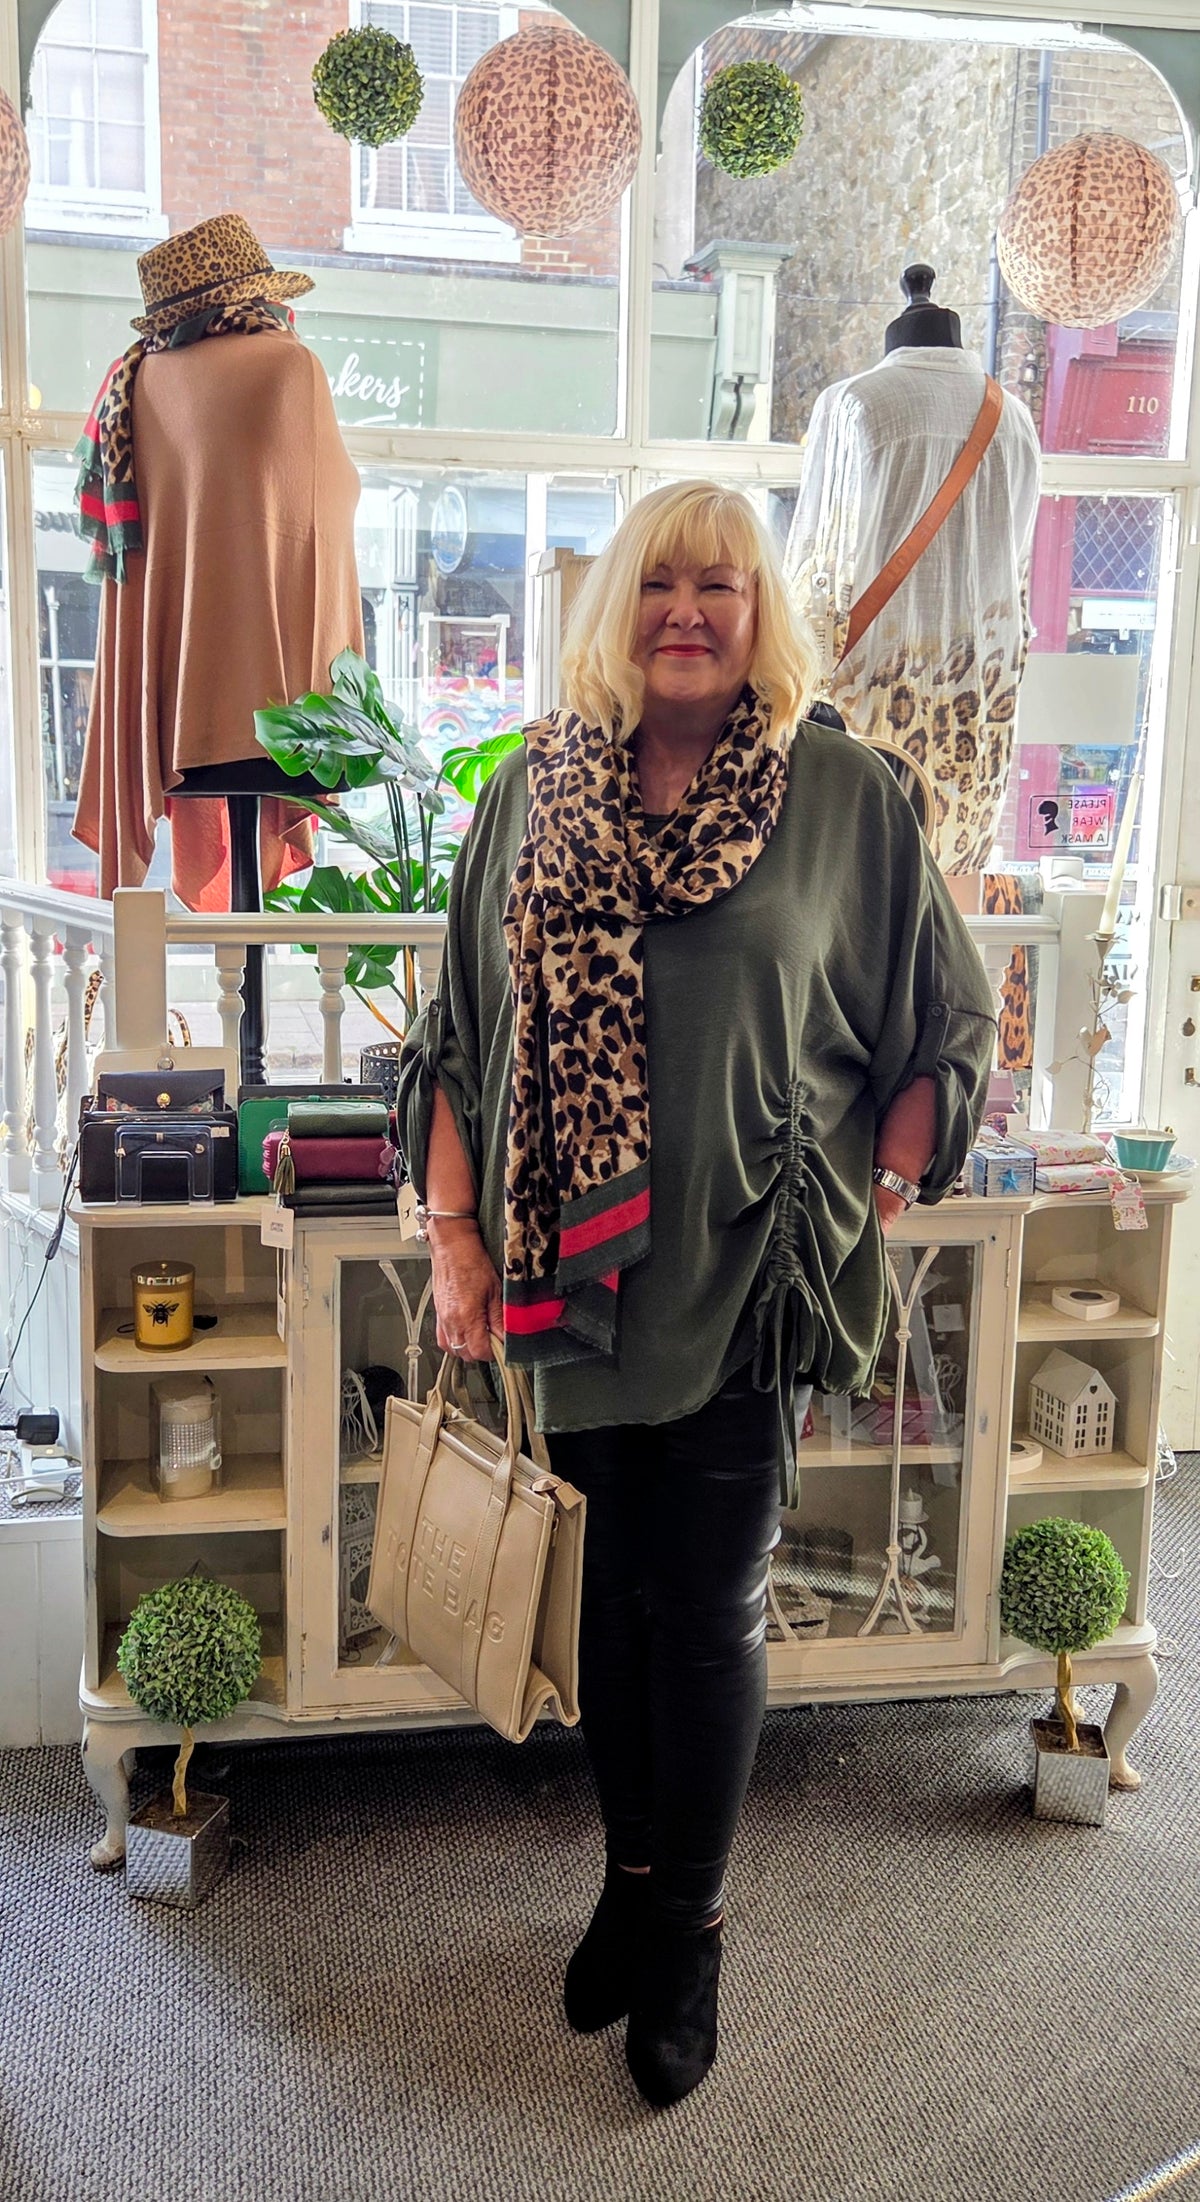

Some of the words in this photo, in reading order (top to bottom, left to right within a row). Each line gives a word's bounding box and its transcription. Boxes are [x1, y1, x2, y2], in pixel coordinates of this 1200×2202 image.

[1127, 395, 1159, 415] 110
[389, 1528, 436, 1599] TOTE
[421, 1516, 467, 1578] THE
[443, 1580, 506, 1643] BAG
